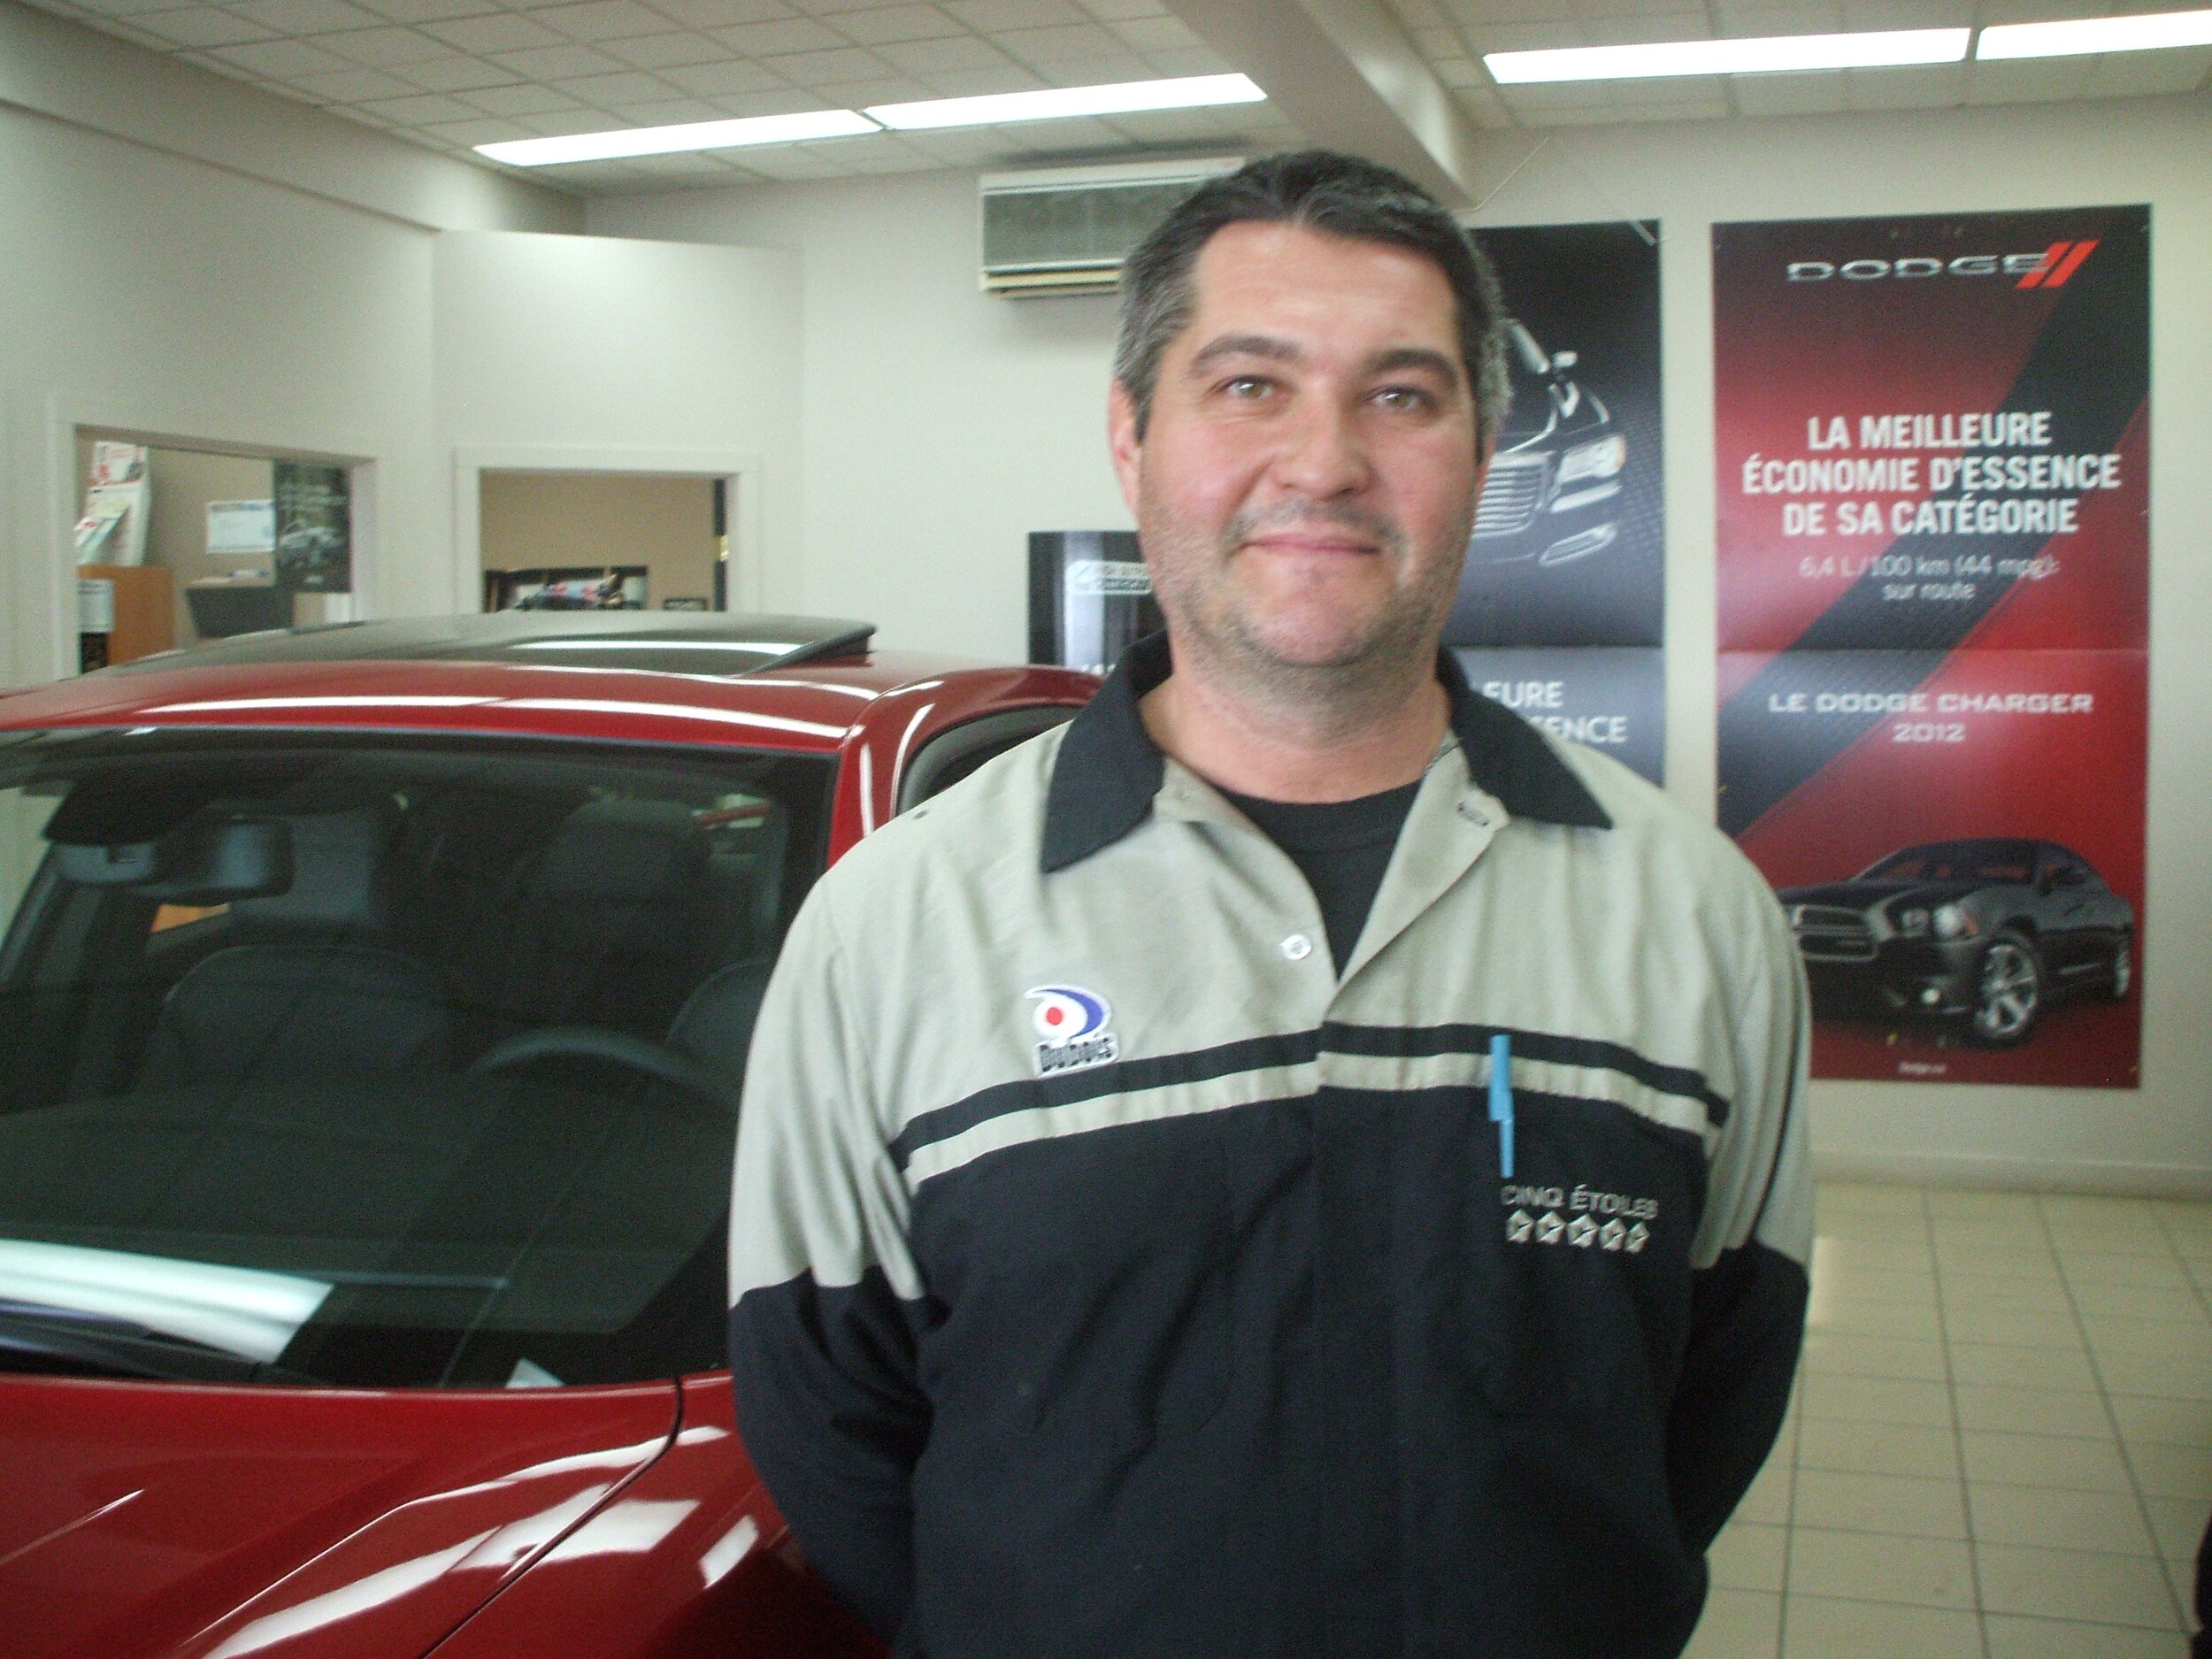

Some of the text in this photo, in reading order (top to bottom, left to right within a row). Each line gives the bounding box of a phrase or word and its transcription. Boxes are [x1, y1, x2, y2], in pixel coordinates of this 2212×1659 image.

[1787, 253, 2049, 281] DODGE
[1808, 412, 2053, 450] LA MEILLEURE
[1742, 453, 2123, 494] ÉCONOMIE D'ESSENCE
[1783, 492, 2080, 535] DE SA CATÉGORIE
[1882, 580, 1976, 601] sur route
[1770, 693, 2093, 713] LE DODGE CHARGER
[1892, 723, 1966, 743] 2012
